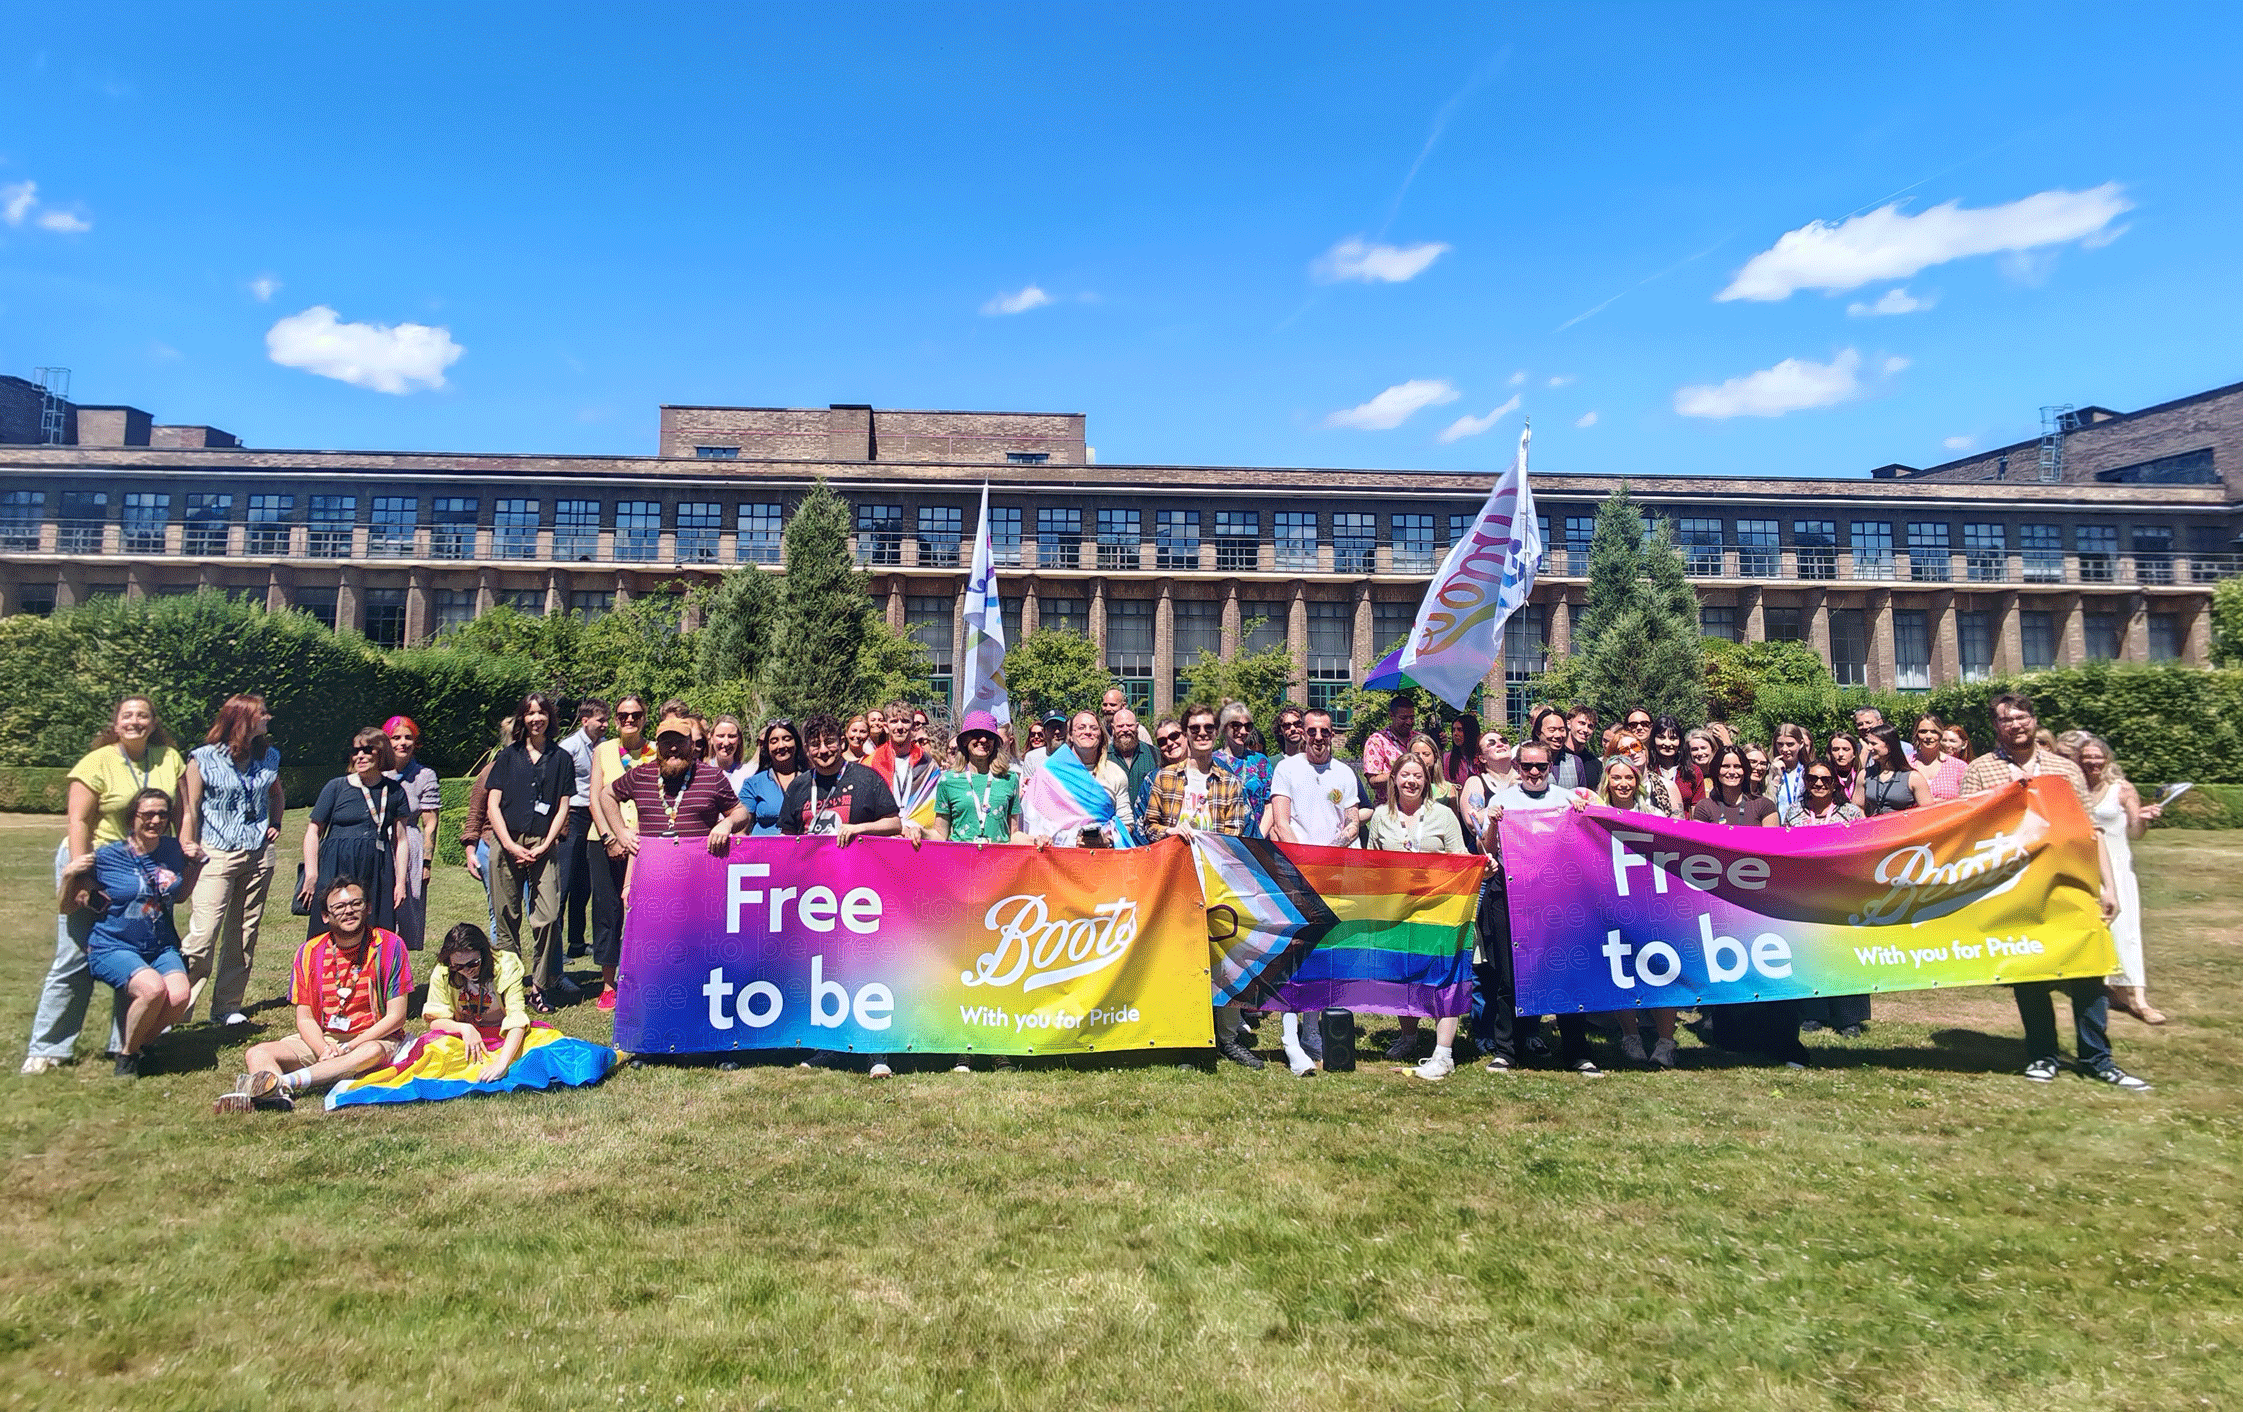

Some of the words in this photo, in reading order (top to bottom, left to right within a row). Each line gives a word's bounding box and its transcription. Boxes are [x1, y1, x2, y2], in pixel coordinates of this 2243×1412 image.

[727, 863, 883, 934] Free
[1612, 831, 1772, 898] Free
[1848, 832, 2034, 928] Boots
[1598, 893, 1637, 926] to
[1645, 886, 1694, 923] be
[701, 929, 744, 963] to
[757, 924, 807, 962] be
[960, 893, 1138, 993] Boots
[1603, 929, 1681, 989] to
[1699, 912, 1792, 983] be
[1854, 944, 1907, 966] With
[1909, 946, 1948, 969] you
[1951, 940, 1982, 960] for
[1986, 934, 2044, 957] Pride
[703, 967, 783, 1030] to
[811, 954, 894, 1030] be
[960, 1005, 1009, 1027] With
[1015, 1013, 1051, 1033] you
[1053, 1008, 1084, 1029] for
[1090, 1004, 1140, 1026] Pride
